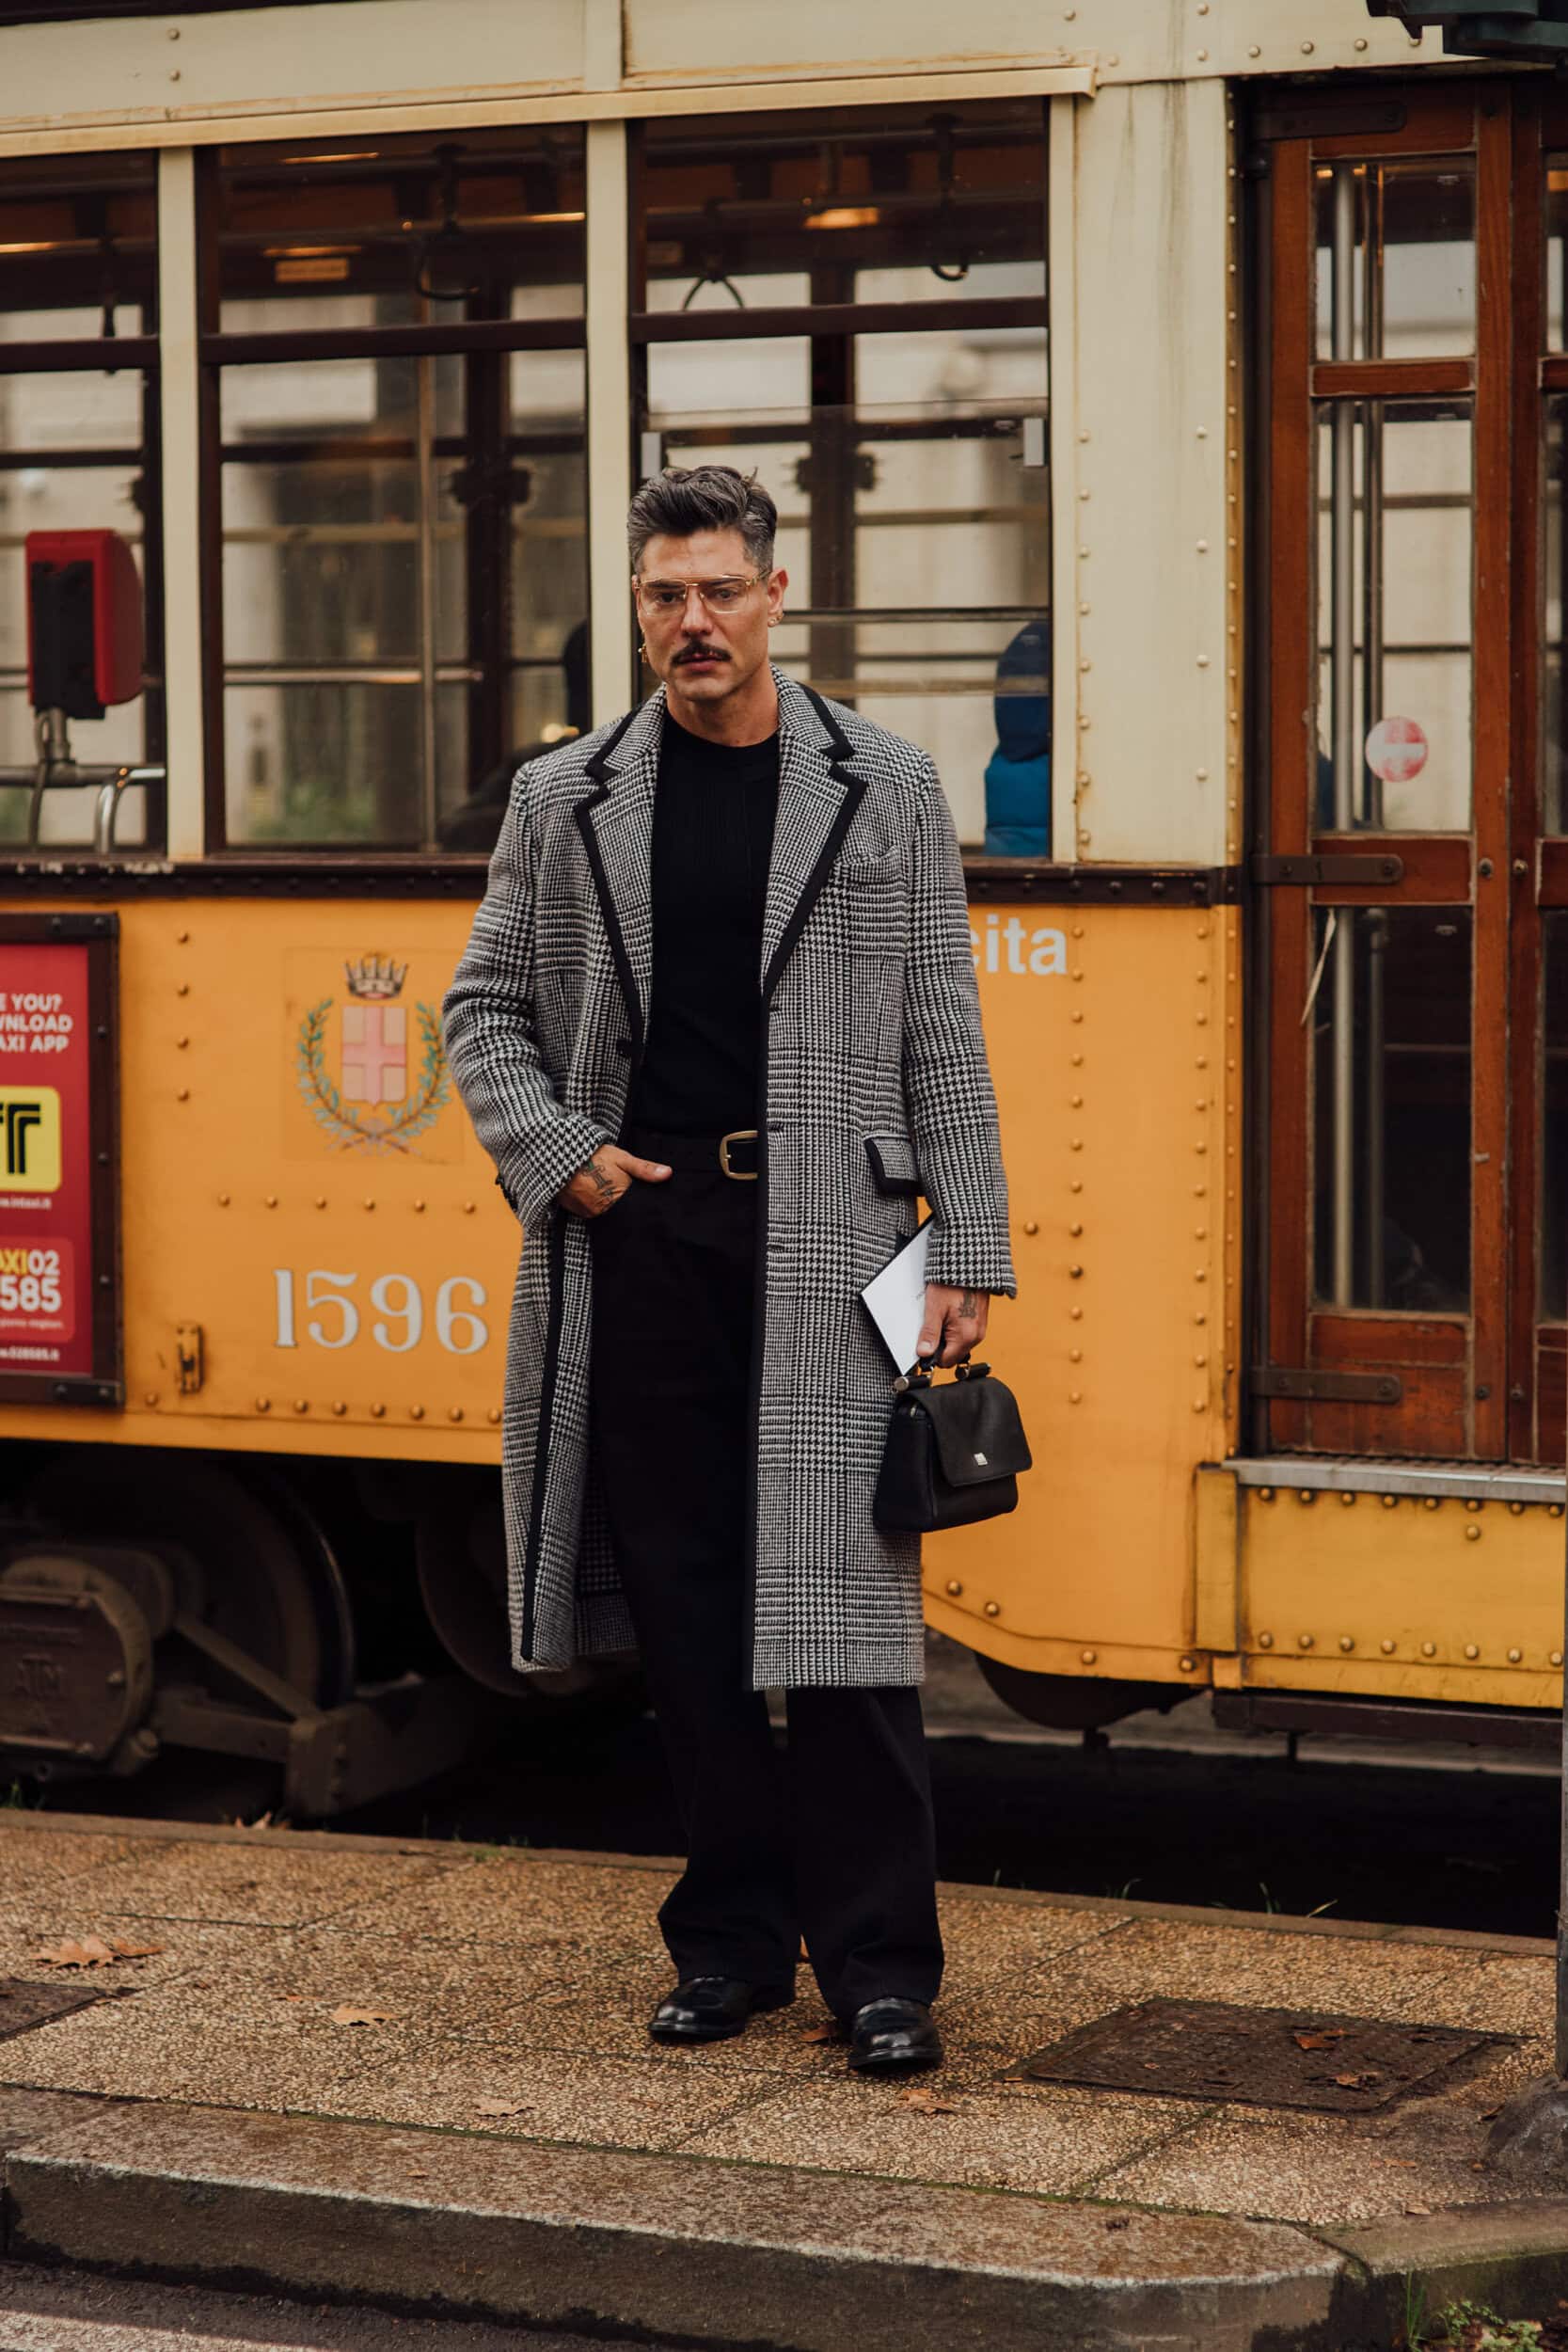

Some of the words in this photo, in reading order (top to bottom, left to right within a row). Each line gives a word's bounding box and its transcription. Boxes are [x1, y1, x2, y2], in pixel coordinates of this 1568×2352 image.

[11, 993, 63, 1013] YOU?
[29, 1034, 70, 1053] APP
[0, 1275, 62, 1313] 585
[273, 1268, 488, 1355] 1596
